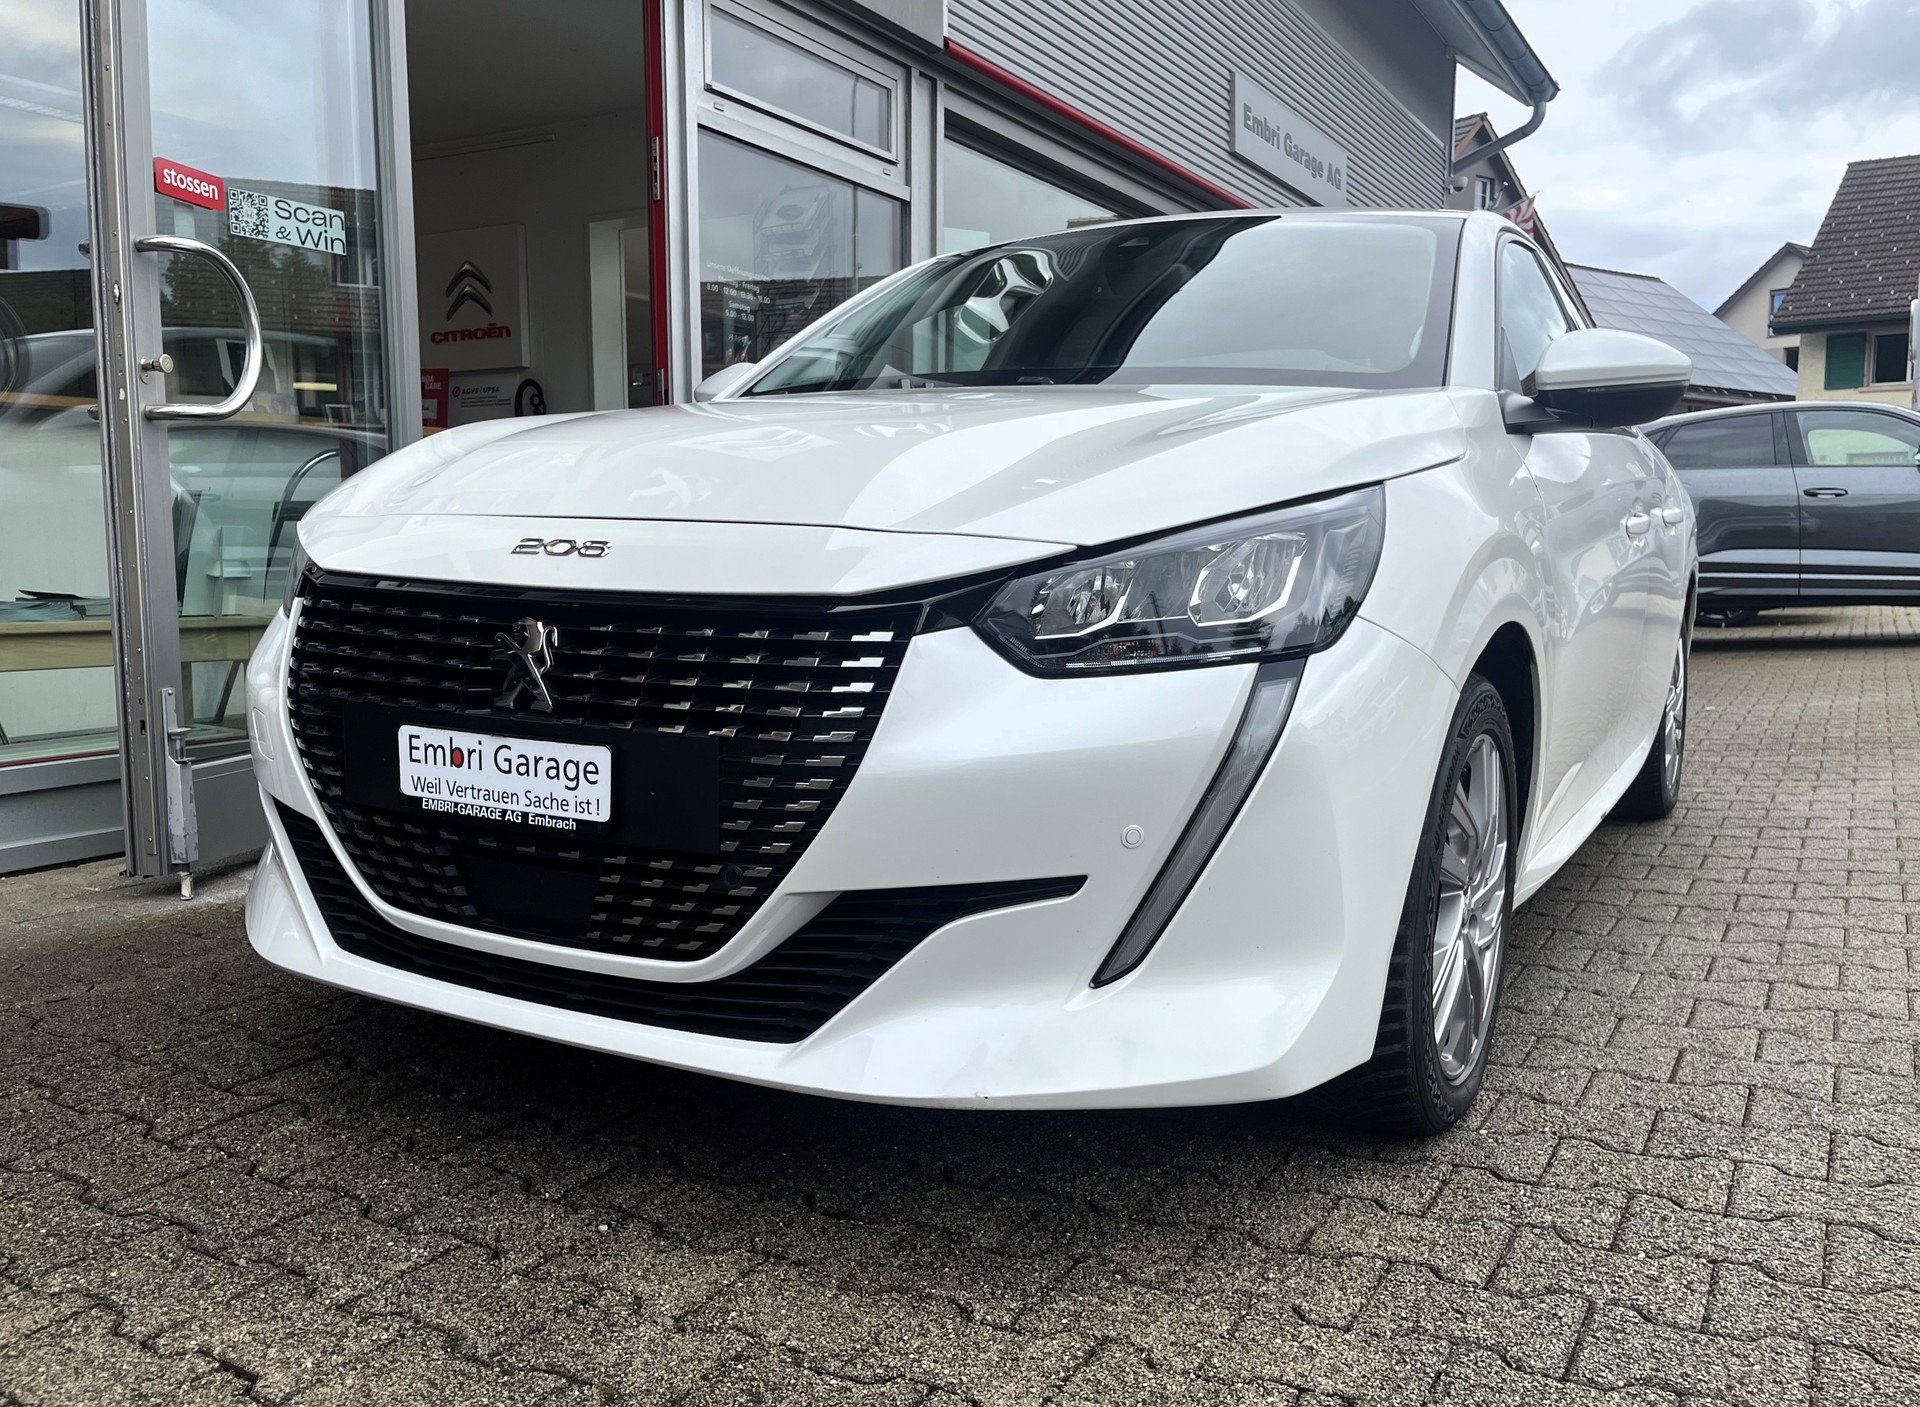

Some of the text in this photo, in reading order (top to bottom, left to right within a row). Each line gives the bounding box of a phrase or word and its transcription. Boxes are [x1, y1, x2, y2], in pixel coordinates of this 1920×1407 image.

[1243, 103, 1342, 191] Embri Garage AG
[163, 168, 218, 200] stossen
[274, 200, 345, 231] Scan
[275, 226, 346, 254] & Win
[723, 287, 736, 296] 12.00
[742, 281, 760, 293] Freitag
[728, 300, 750, 312] Samstag
[741, 312, 754, 321] 12.00
[510, 538, 611, 558] 208
[408, 734, 600, 791] Embri Garage
[411, 775, 441, 795] Weil
[446, 779, 519, 806] Vertrauen
[525, 790, 569, 812] Sache
[574, 795, 592, 815] ist
[422, 798, 576, 831] EMBRI-GARAGE AG Embrach
